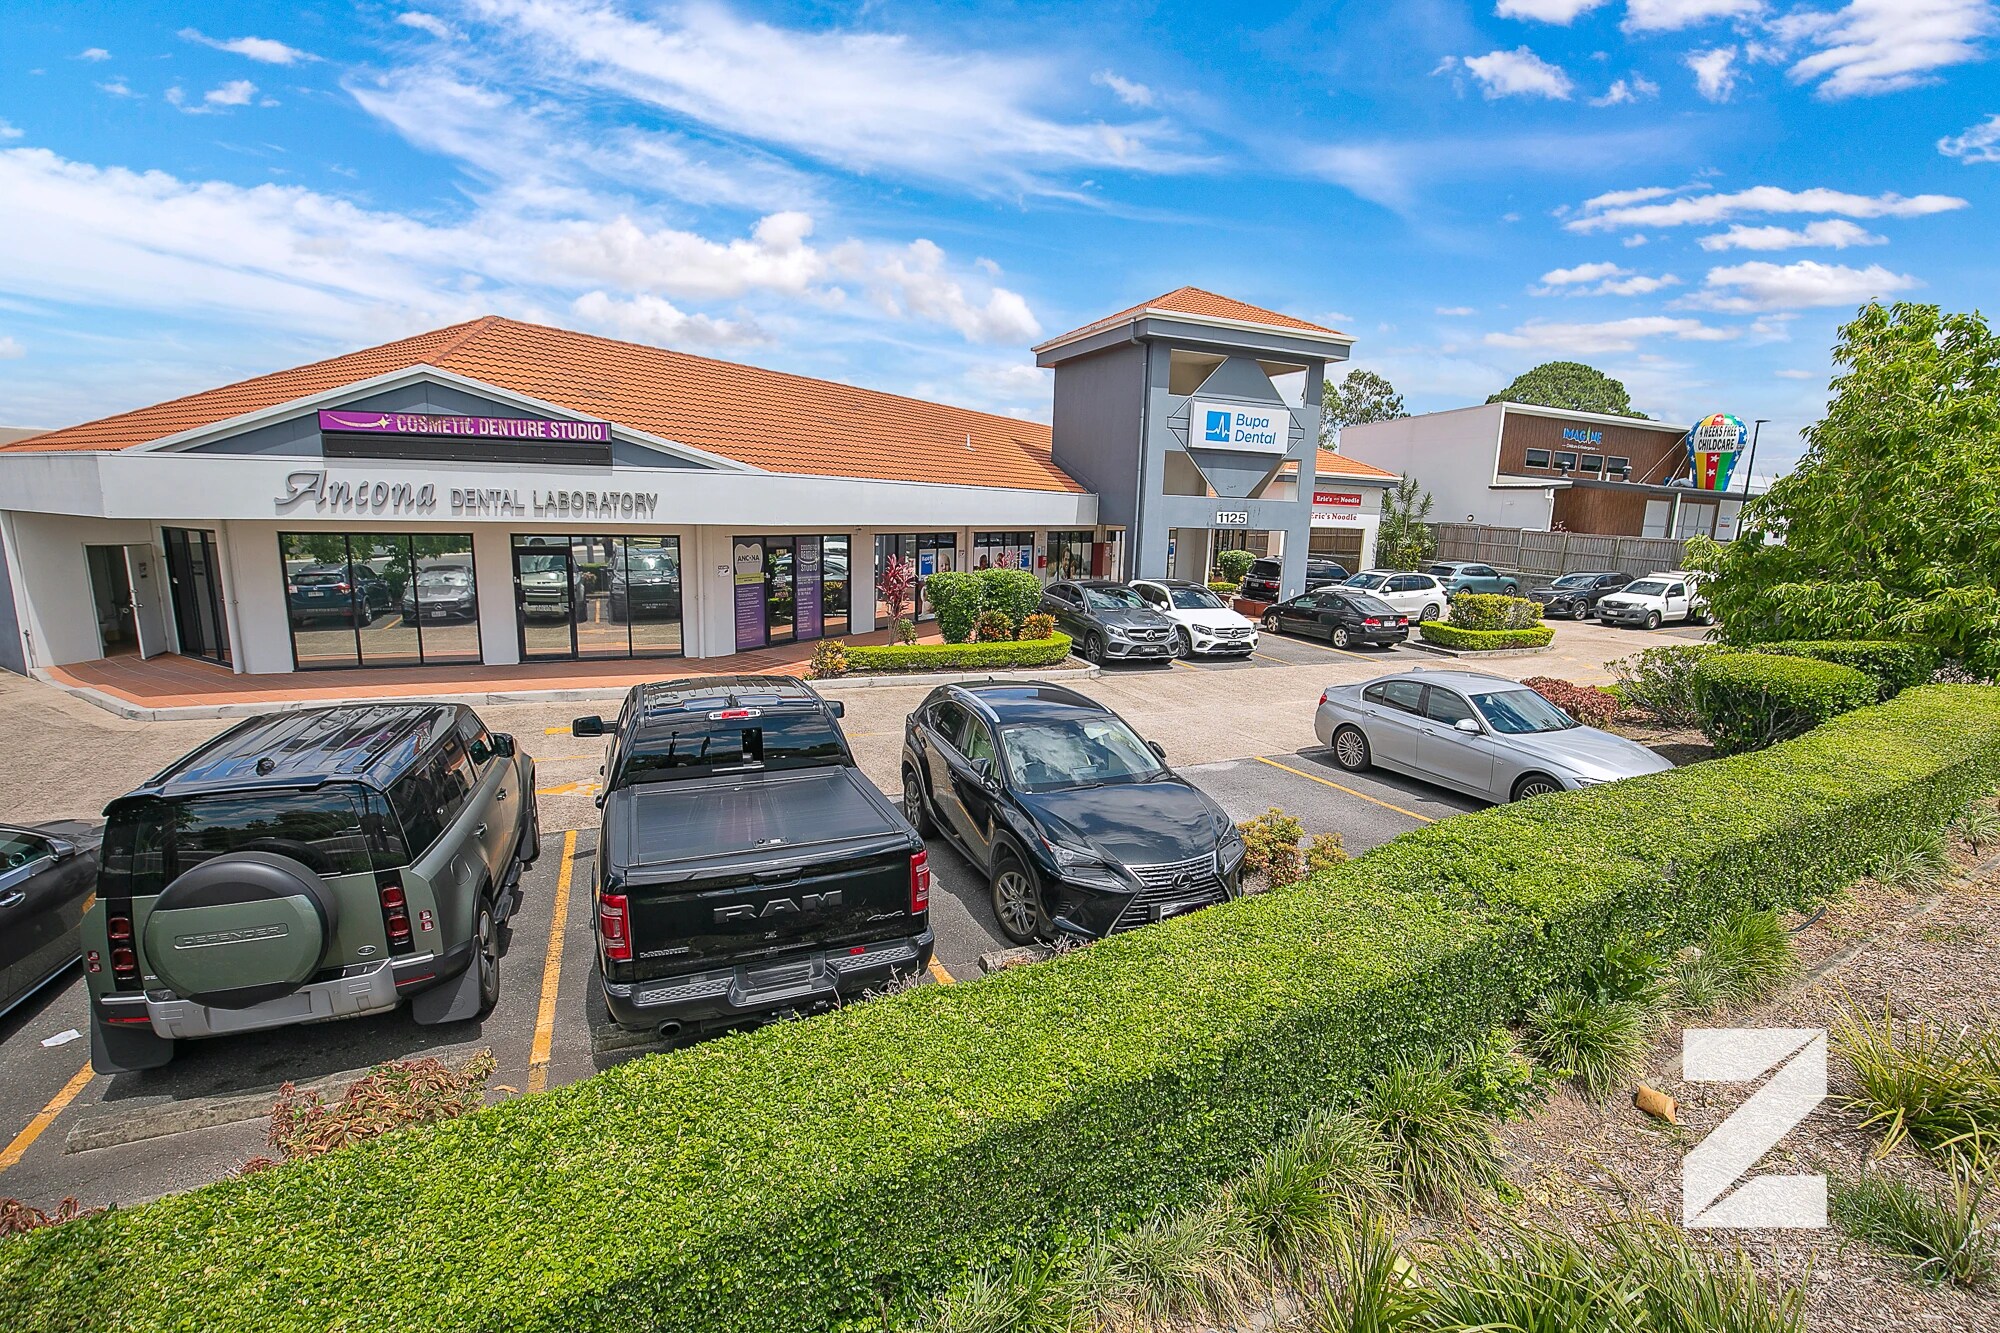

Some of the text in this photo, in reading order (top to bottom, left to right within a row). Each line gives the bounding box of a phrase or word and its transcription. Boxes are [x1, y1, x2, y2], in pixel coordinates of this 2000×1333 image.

[396, 413, 602, 441] COSMETIC DENTURE STUDIO
[1235, 413, 1270, 430] Bupa
[1234, 429, 1277, 445] Dental
[1704, 425, 1724, 438] WEEKS
[1723, 425, 1737, 437] FREE
[1697, 438, 1735, 451] CHILDCARE
[273, 469, 659, 511] Ancona DENTAL LABORATORY
[1316, 495, 1360, 504] Eric's Noodle
[1217, 513, 1247, 524] 1125
[1331, 512, 1357, 521] Noodle
[713, 889, 844, 926] RAM
[182, 926, 281, 944] DEFENDER
